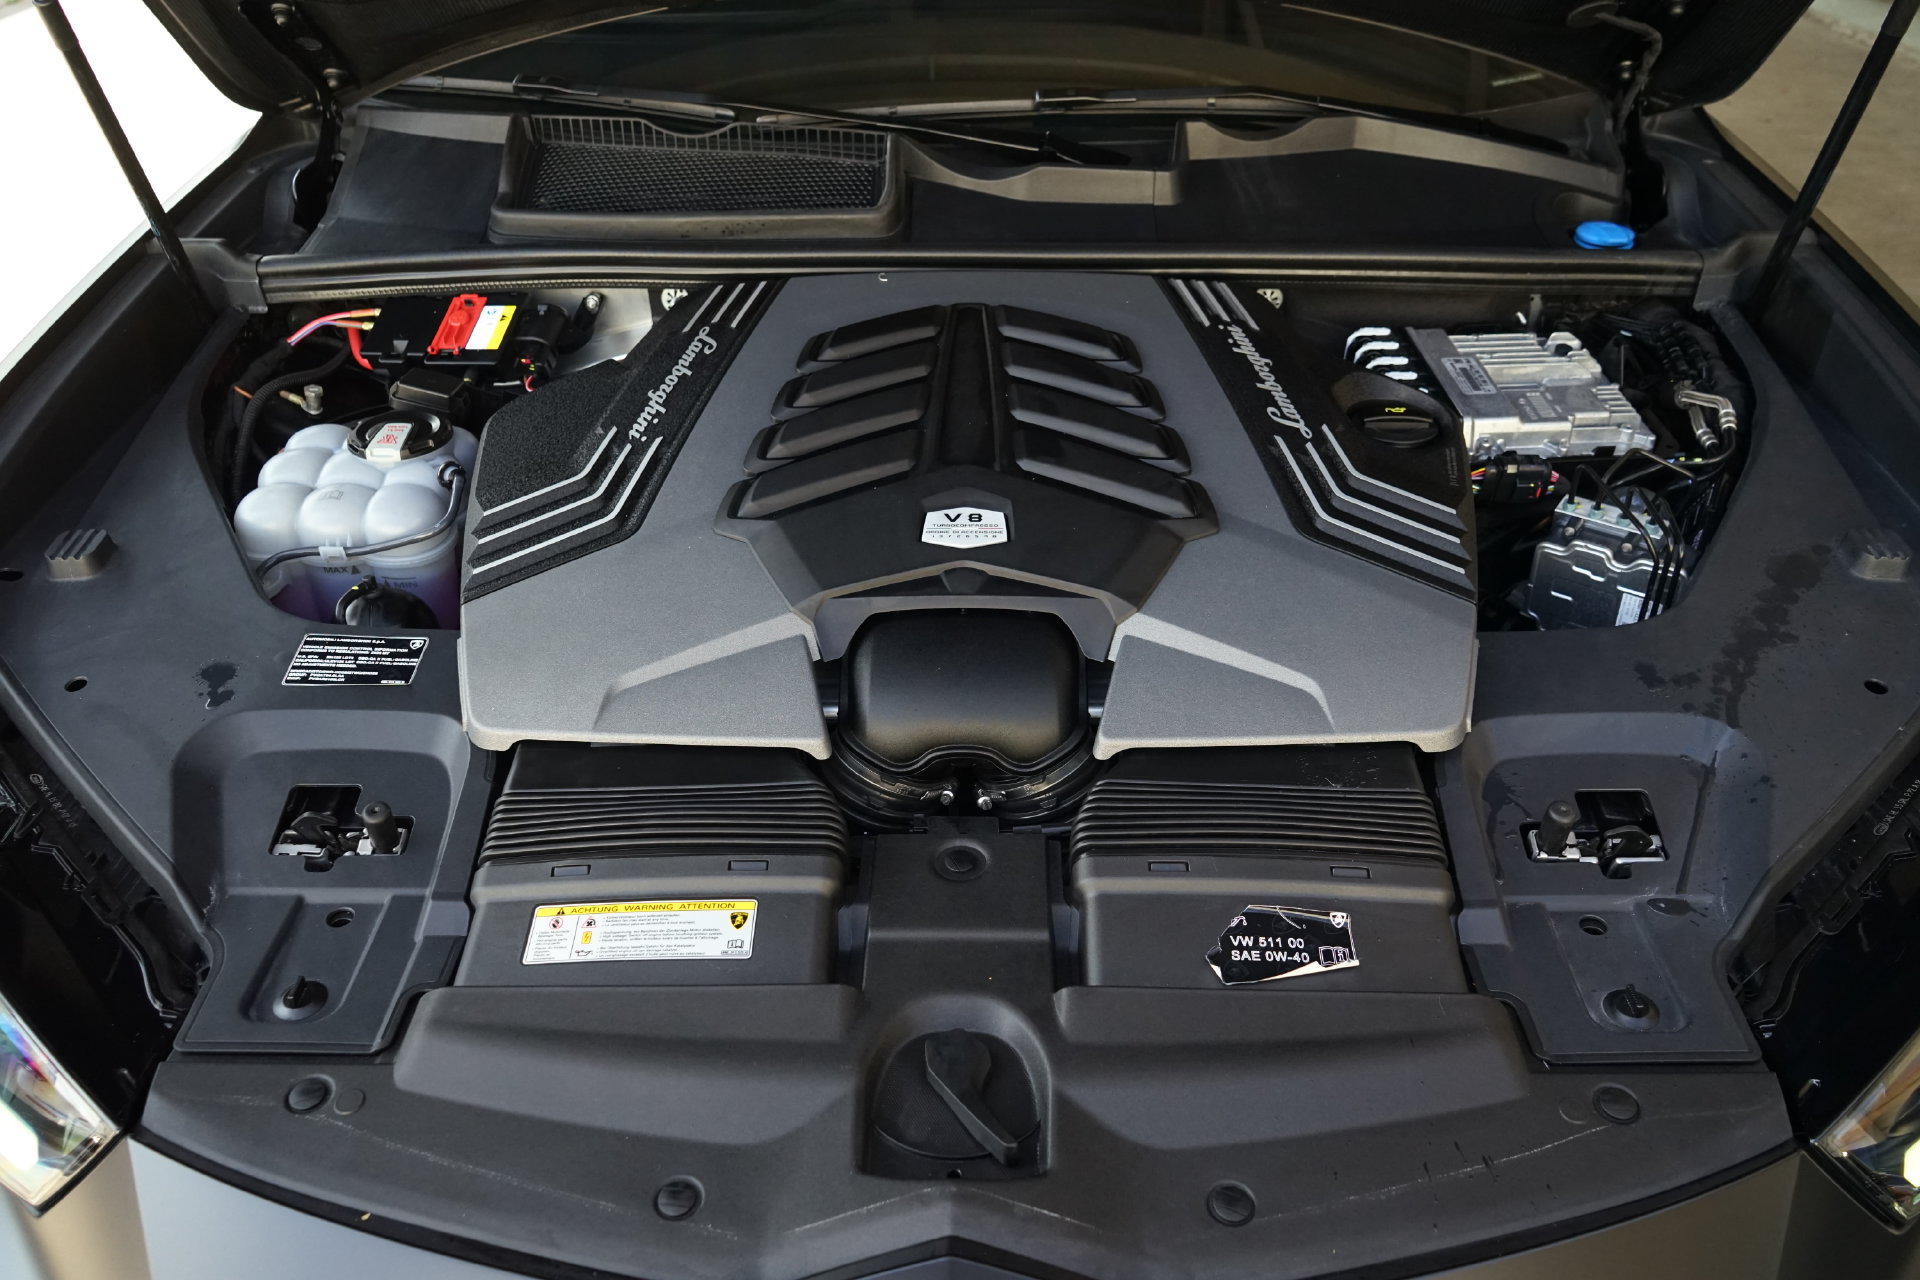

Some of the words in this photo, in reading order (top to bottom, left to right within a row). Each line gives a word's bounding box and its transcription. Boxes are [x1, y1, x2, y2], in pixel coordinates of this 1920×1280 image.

[629, 326, 717, 441] Lamborghini
[1218, 324, 1312, 439] Lamborghini
[570, 905, 619, 914] ACHTUNG
[624, 903, 674, 912] WARNING
[679, 902, 736, 910] ATTENTION
[1230, 935, 1254, 947] VW
[1258, 936, 1283, 948] 511
[1287, 937, 1305, 949] 00
[1231, 950, 1262, 962] SAE
[1265, 950, 1310, 963] 0W-40
